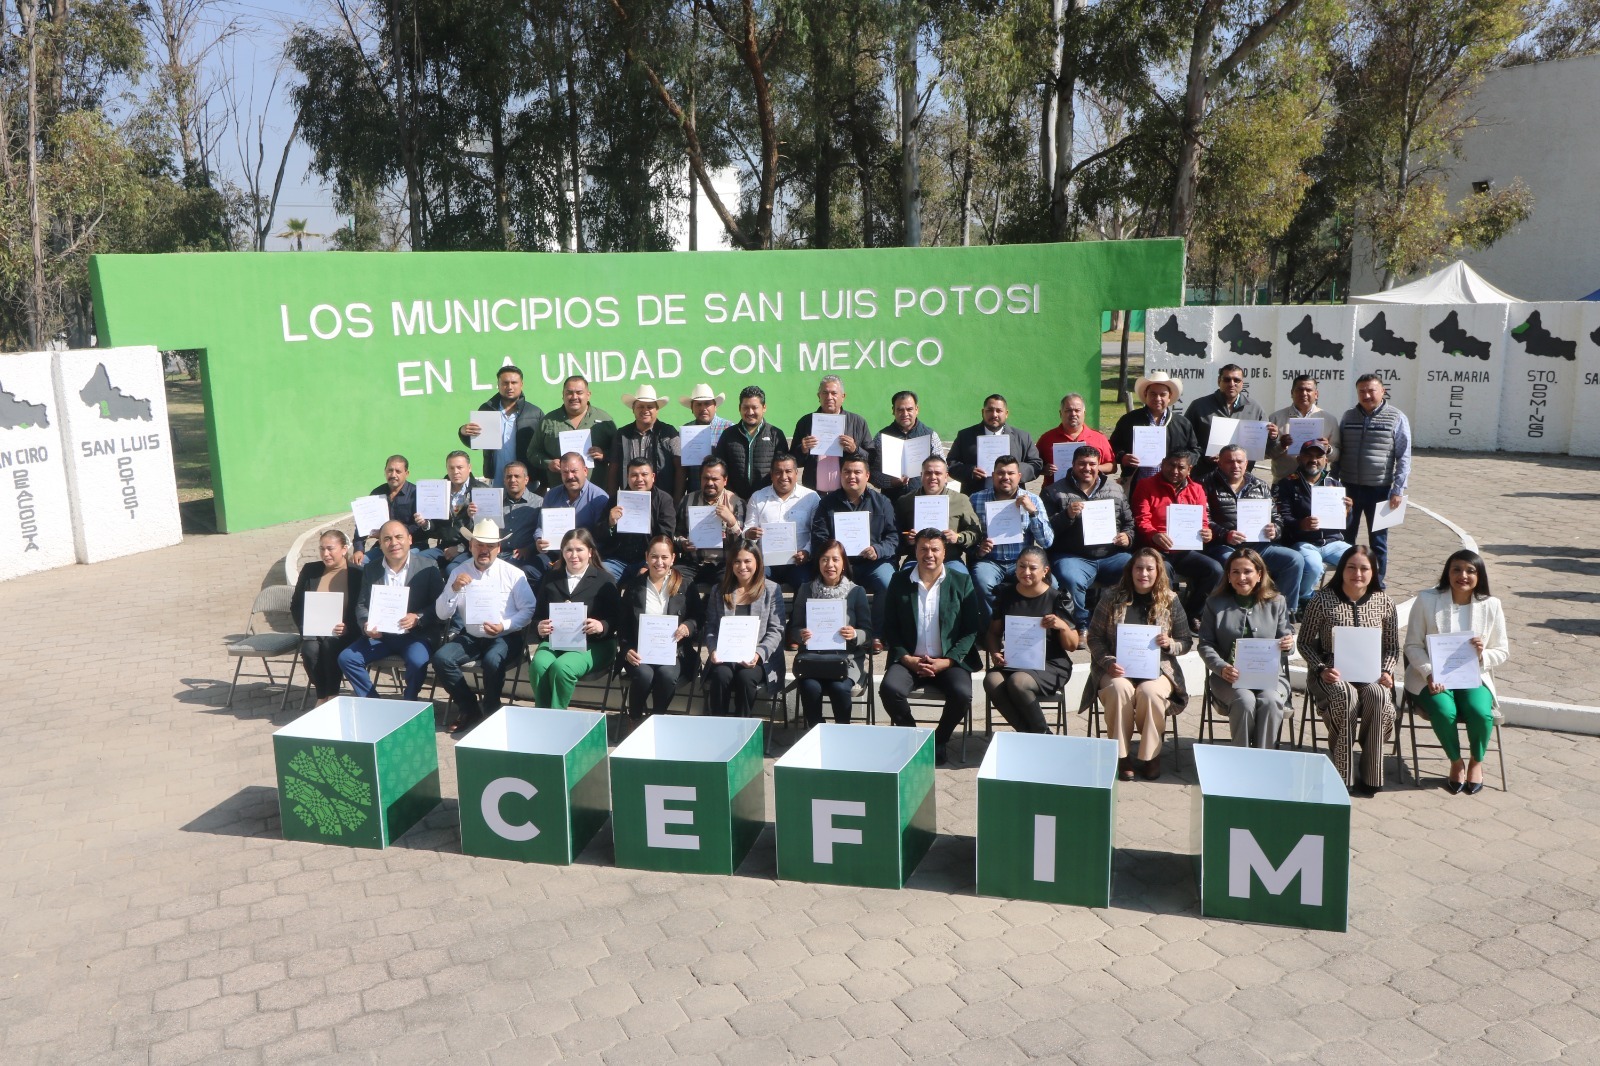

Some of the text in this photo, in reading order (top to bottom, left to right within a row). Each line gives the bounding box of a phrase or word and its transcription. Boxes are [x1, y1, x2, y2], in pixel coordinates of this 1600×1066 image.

[280, 284, 1041, 342] LOS MUNICIPIOS DE SAN LUIS POTOSI
[398, 359, 453, 396] EN
[541, 347, 683, 385] UNIDAD
[700, 343, 782, 376] CON
[799, 337, 943, 372] MEXICO
[1170, 368, 1205, 379] MARTIN
[1251, 367, 1261, 378] DE
[1527, 369, 1558, 384] STO.
[81, 433, 160, 458] SAN LUIS
[15, 446, 48, 465] CIRO
